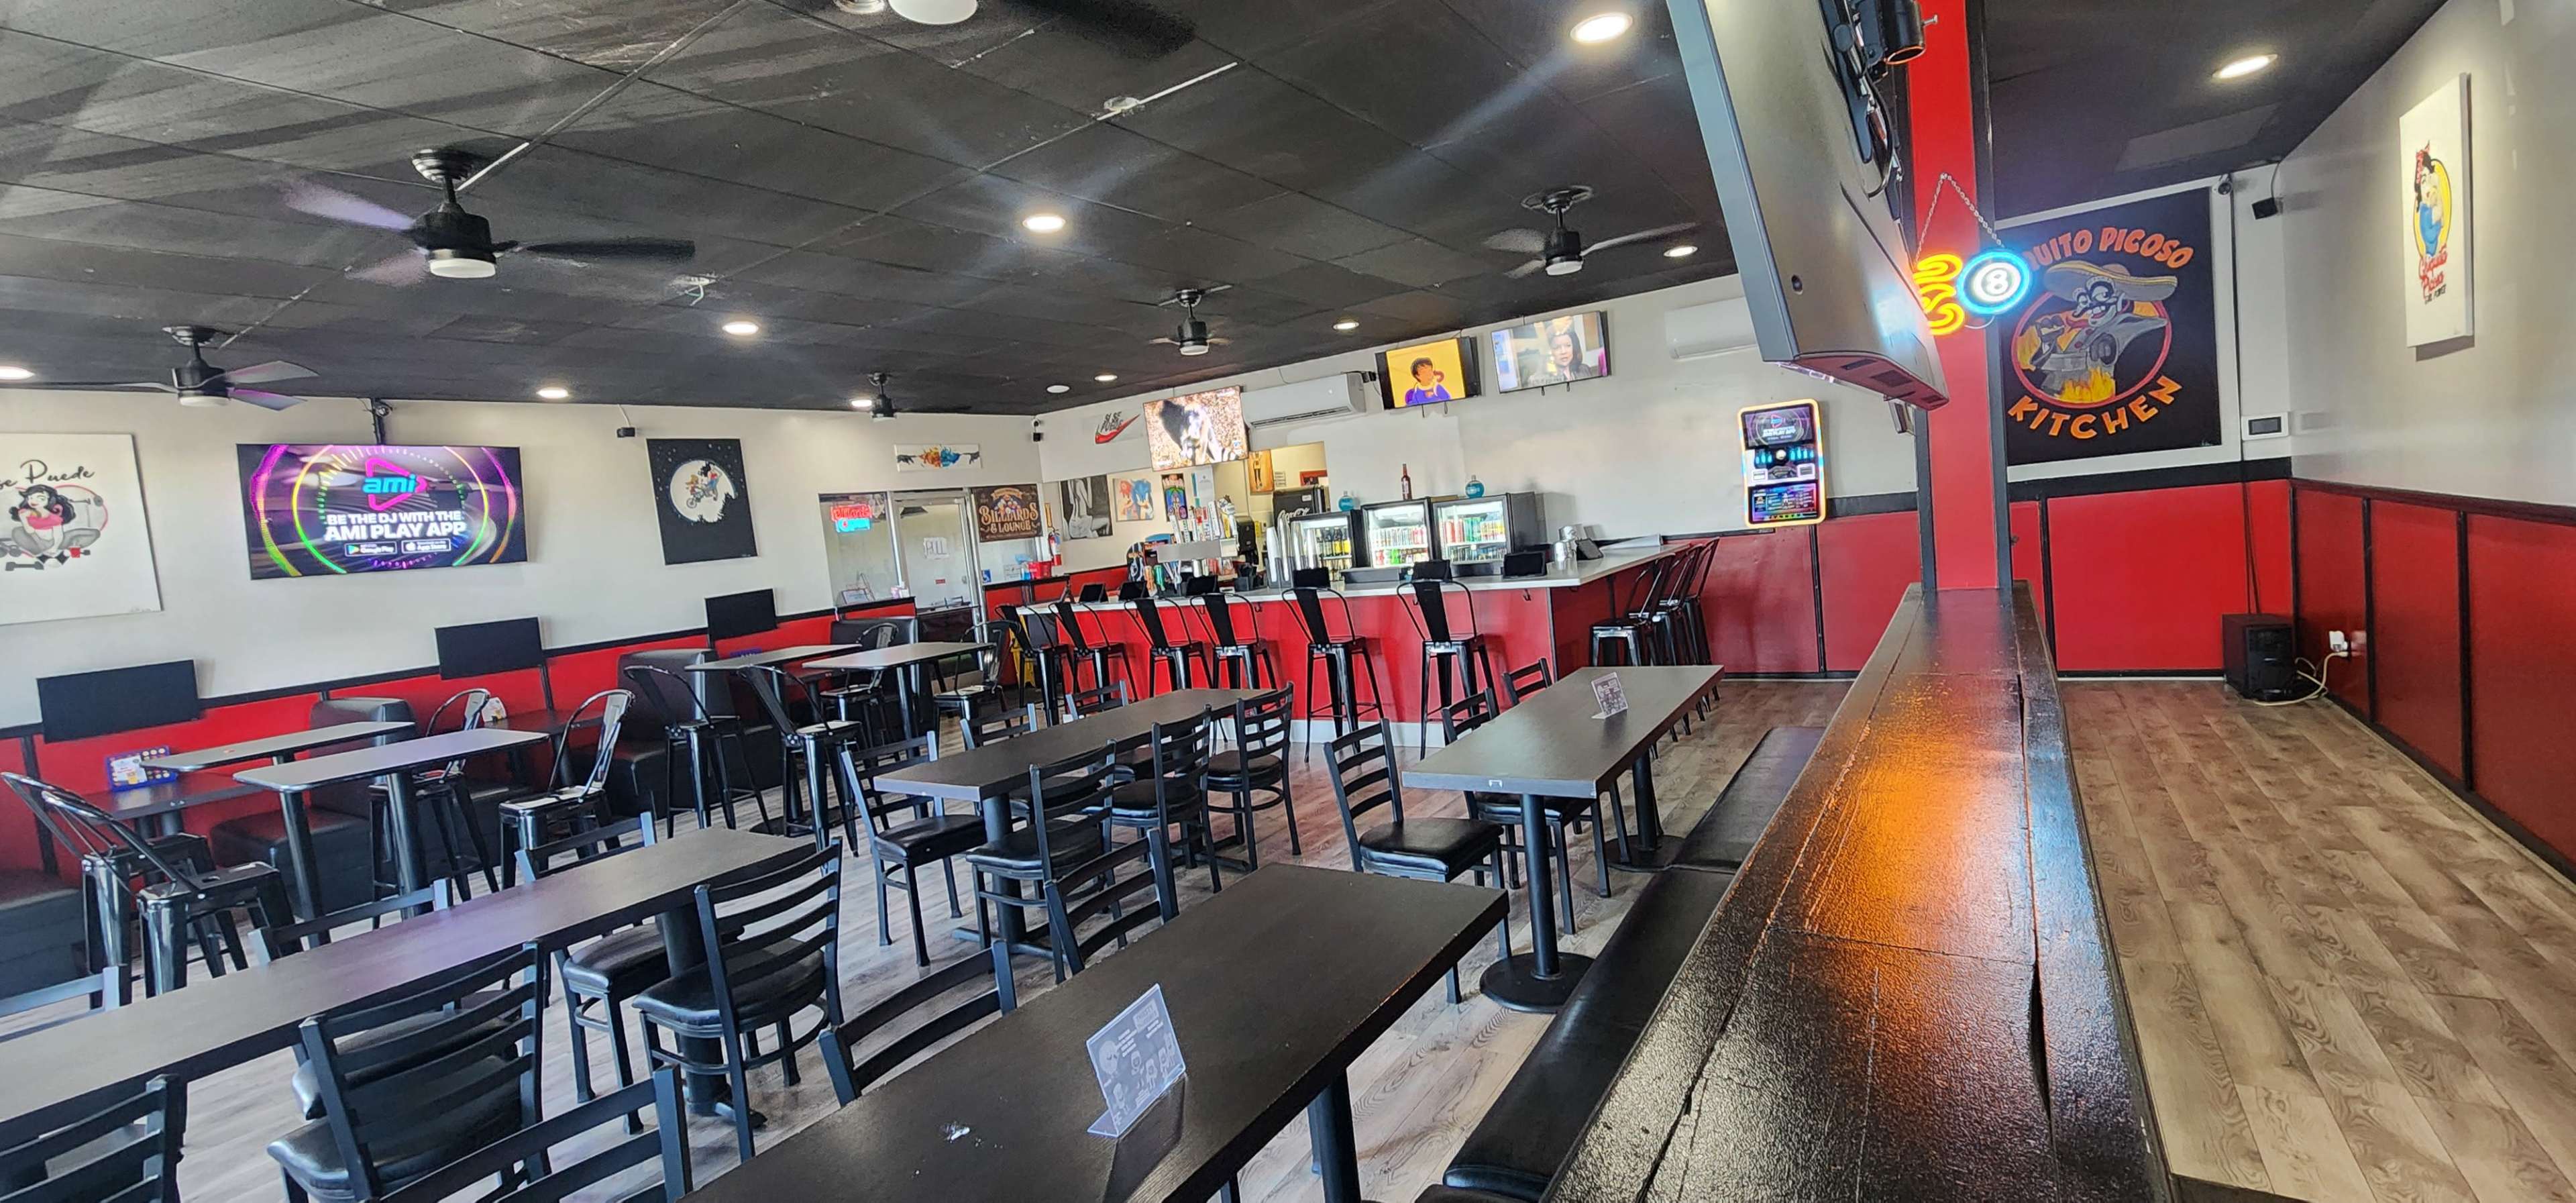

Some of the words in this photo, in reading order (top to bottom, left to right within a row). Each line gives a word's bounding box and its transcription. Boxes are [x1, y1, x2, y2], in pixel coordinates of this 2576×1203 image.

[2098, 227, 2194, 268] PICOSO
[2008, 375, 2183, 439] KITCHEN
[20, 460, 95, 484] Puede
[362, 474, 417, 494] ami
[326, 515, 347, 525] BE
[347, 513, 377, 524] THE
[378, 513, 398, 523] DJ
[398, 511, 434, 523] WITH
[434, 510, 463, 521] THE
[979, 503, 1038, 525] BILLIARDS
[325, 525, 367, 541] AMI
[370, 523, 424, 539] PLAY
[426, 521, 467, 537] APP
[990, 523, 998, 534] &
[998, 519, 1031, 533] LOUNGE
